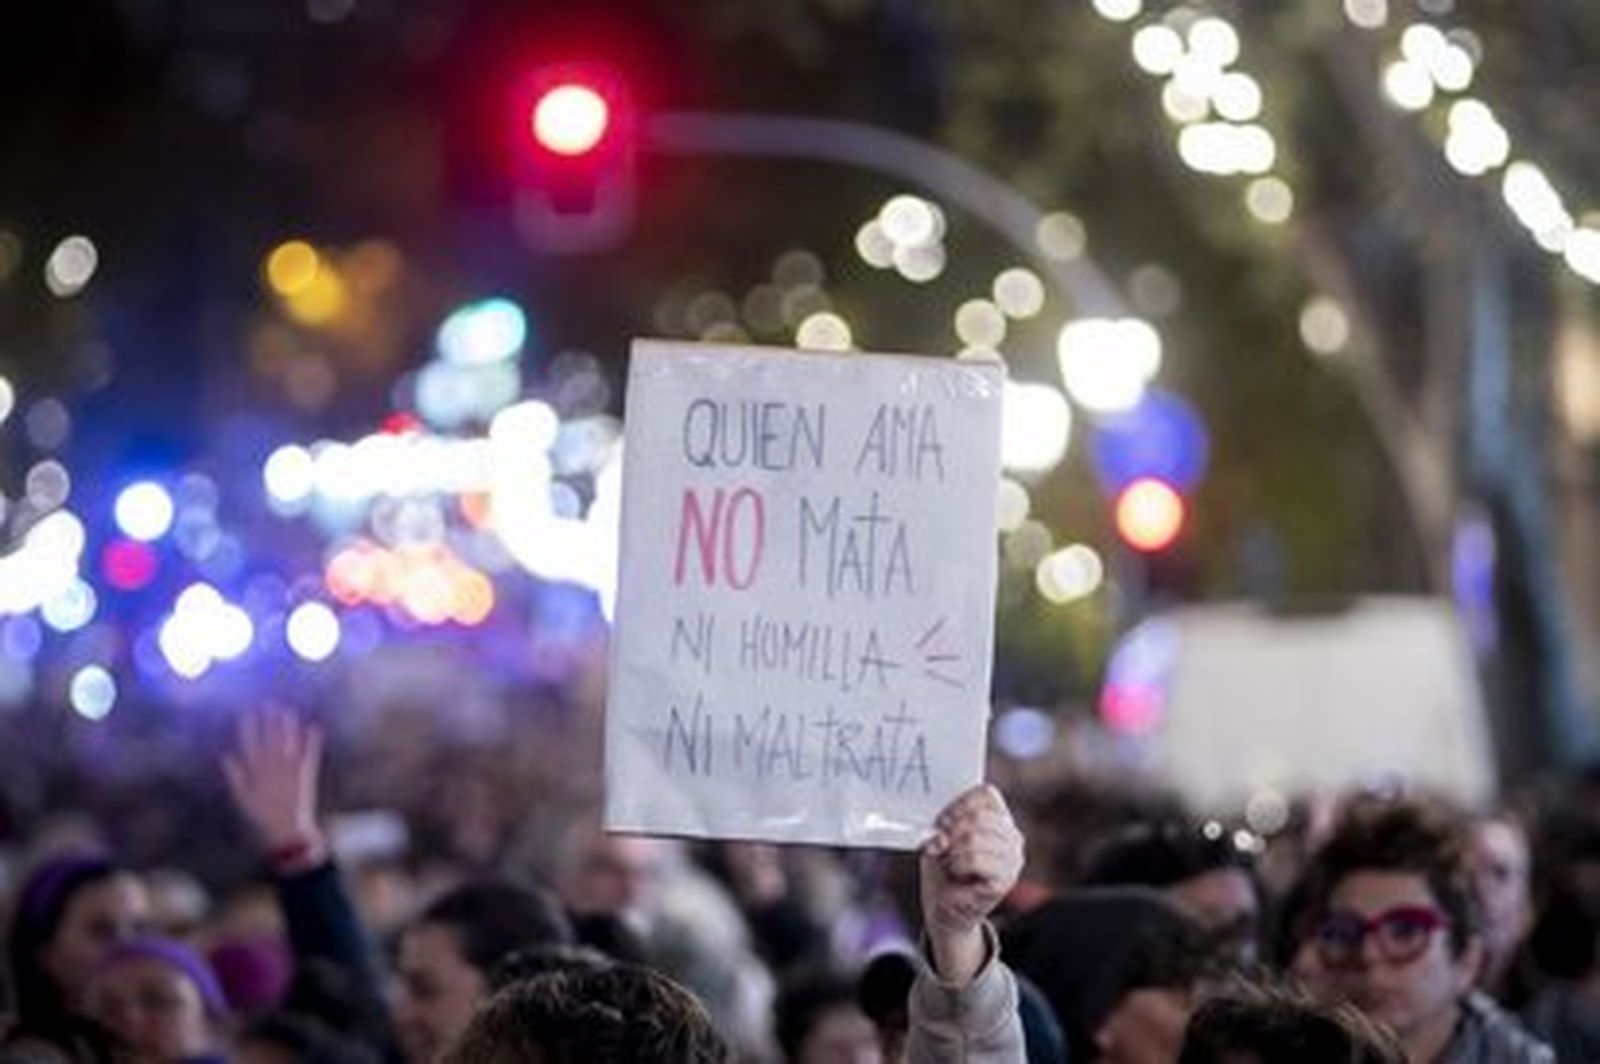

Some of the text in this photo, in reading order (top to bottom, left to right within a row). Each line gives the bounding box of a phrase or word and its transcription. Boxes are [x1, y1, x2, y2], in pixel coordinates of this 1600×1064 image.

[682, 398, 945, 483] QUIEN AMA
[674, 487, 766, 591] NO
[670, 614, 901, 692] NI HUMILLA
[664, 693, 931, 794] NI MALTRATA
